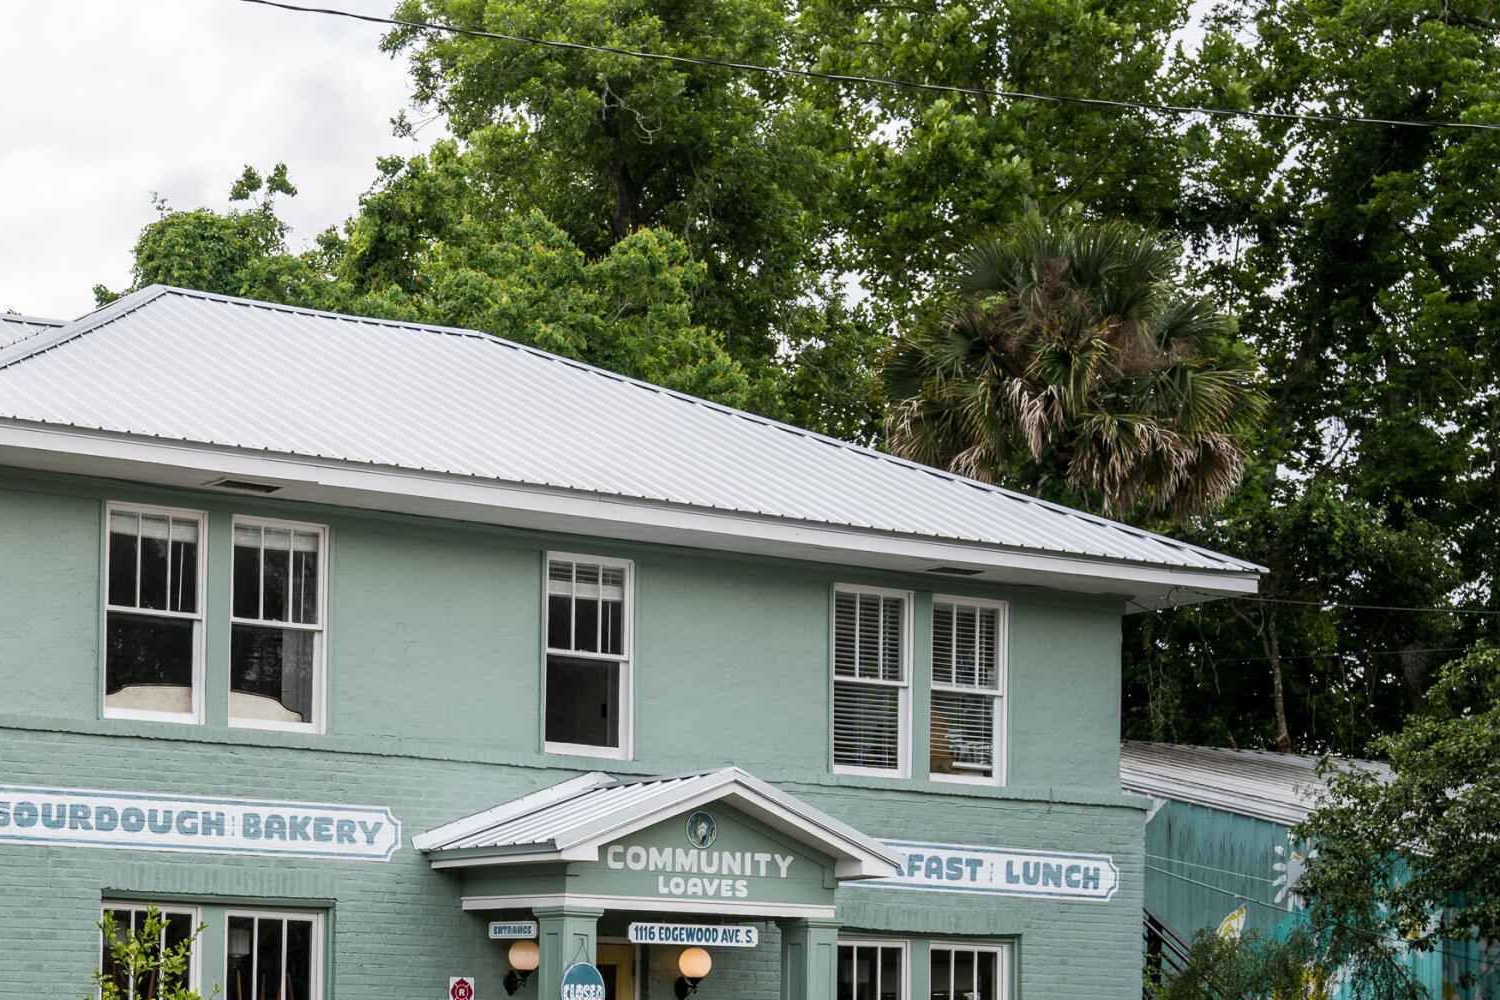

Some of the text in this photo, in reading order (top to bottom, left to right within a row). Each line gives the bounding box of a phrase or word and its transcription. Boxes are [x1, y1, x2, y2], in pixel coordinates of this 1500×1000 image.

[242, 812, 384, 845] BAKERY
[607, 845, 794, 877] COMMUNITY
[658, 875, 748, 897] LOAVES
[1005, 860, 1100, 890] LUNCH
[493, 925, 532, 935] ENTRANCE
[634, 925, 754, 944] 1116 EDGEWOOD AVE. S.
[459, 988, 465, 996] R
